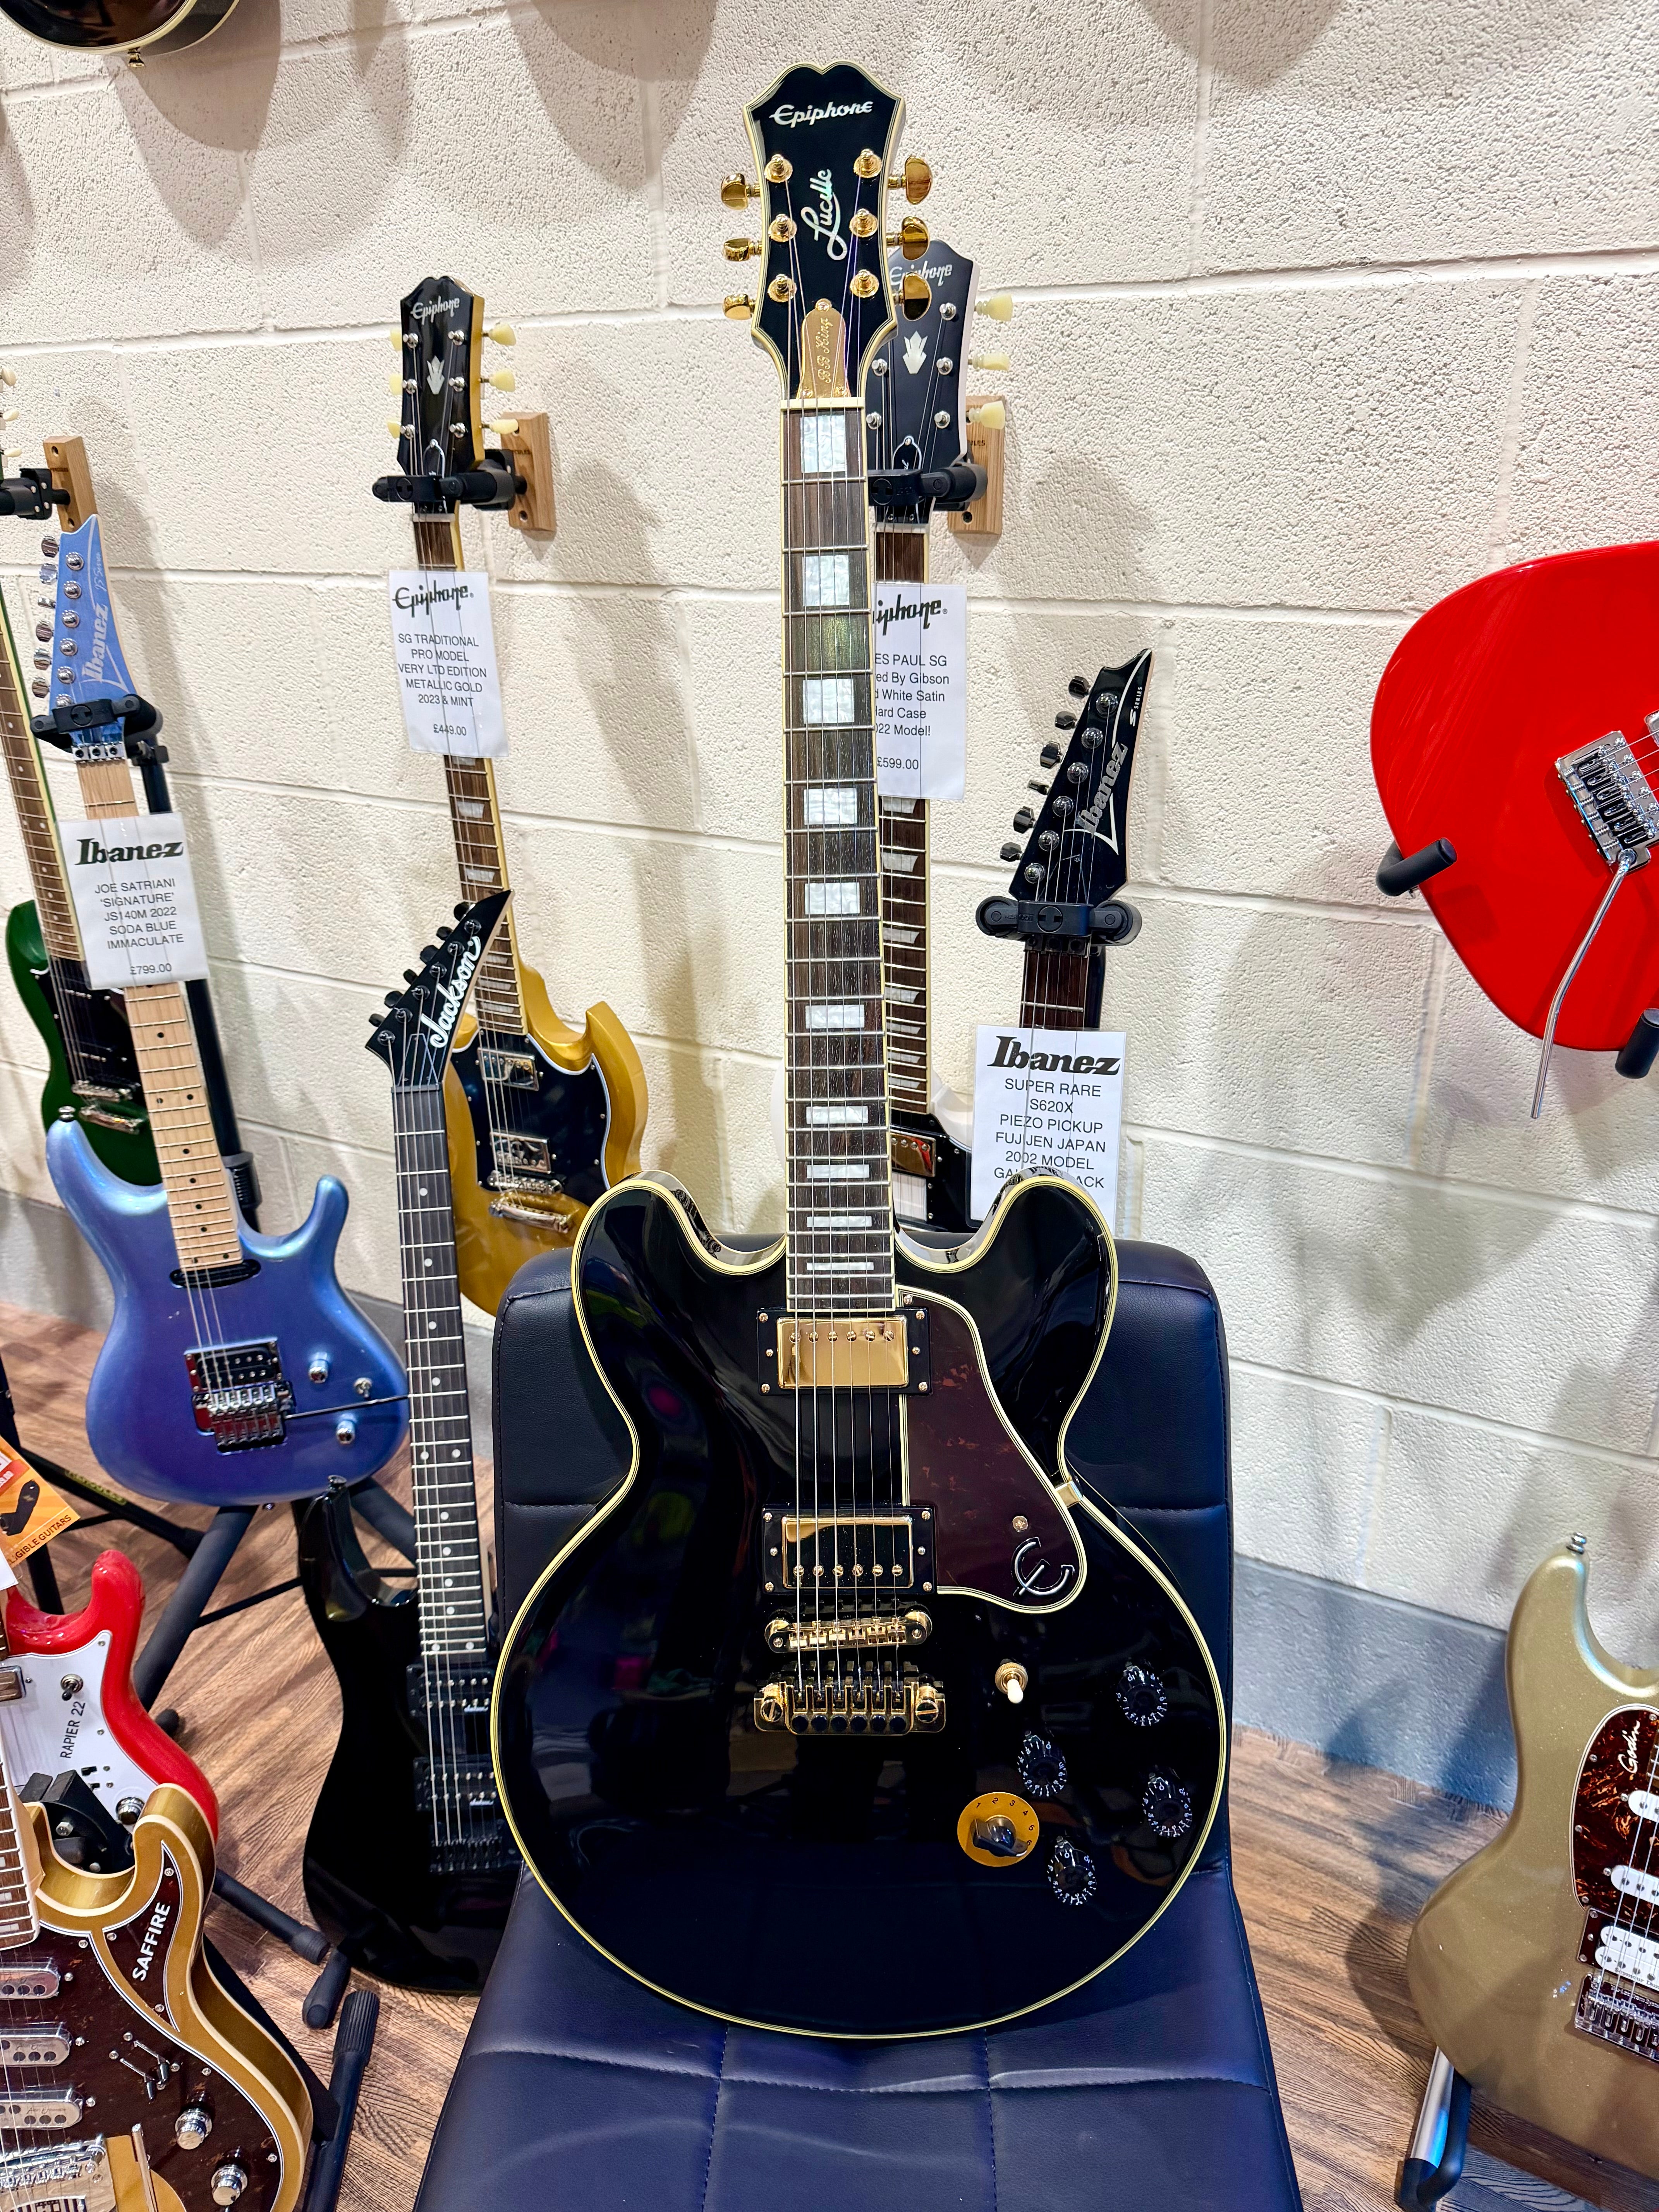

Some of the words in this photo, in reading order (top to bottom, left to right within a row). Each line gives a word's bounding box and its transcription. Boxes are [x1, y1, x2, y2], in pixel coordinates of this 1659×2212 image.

[769, 101, 873, 128] Epiphone
[800, 169, 847, 260] Lucille
[889, 260, 953, 291] Ephone
[410, 295, 460, 325] Epiphone
[816, 318, 833, 354] King
[392, 580, 469, 618] Epiphone
[872, 594, 941, 635] iphone
[81, 603, 108, 683] Ibanez
[398, 633, 412, 644] SG
[414, 634, 479, 647] TRADITIONAL
[411, 649, 433, 659] PRO
[436, 650, 469, 661] MODEL
[875, 653, 890, 665] ES
[893, 654, 926, 666] PAUL
[929, 655, 947, 666] SG
[398, 663, 424, 673] VERY
[427, 665, 445, 675] LTD
[447, 666, 487, 678] EDITION
[876, 672, 888, 682] ed
[892, 672, 906, 686] By
[909, 672, 949, 685] Gibson
[406, 678, 452, 690] METALLIC
[455, 682, 483, 692] GOLD
[418, 694, 440, 704] 2023
[442, 696, 448, 705] &
[451, 696, 474, 707] MINT
[882, 689, 913, 701] White
[916, 690, 945, 702] Satin
[875, 706, 893, 717] ard
[897, 707, 926, 719] Case
[1130, 709, 1136, 727] S
[433, 724, 467, 736] £449.00
[876, 723, 890, 734] 22
[894, 724, 931, 736] Model!
[877, 756, 919, 770] £599.00
[1076, 742, 1128, 840] Ibanez
[74, 838, 184, 866] Ibanez
[95, 883, 117, 894] JOE
[121, 878, 175, 891] SATRIANI
[104, 909, 148, 922] JS140M
[150, 906, 177, 918] 2022
[109, 924, 143, 935] SODA
[146, 920, 177, 931] BLUE
[107, 933, 185, 949] IMMACULATE
[130, 963, 172, 975] £799.00
[420, 936, 481, 1048] Jackson
[987, 1035, 1121, 1075] Ibanez
[1005, 1078, 1054, 1094] SUPER
[1060, 1083, 1101, 1097] RARE
[1030, 1098, 1073, 1113] S620X
[1000, 1114, 1043, 1129] PIEZO
[1048, 1119, 1103, 1134] PICKUP
[1057, 1138, 1106, 1152] JAPAN
[1005, 1151, 1037, 1164] 2002
[1042, 1154, 1094, 1170] MODEL
[994, 1167, 1018, 1178] GA
[1076, 1175, 1104, 1188] ACK
[7, 1538, 40, 1565] LIGIBLE
[38, 1515, 72, 1540] GUITARS
[60, 1720, 81, 1759] RAPIER
[71, 1701, 86, 1716] 22
[1618, 1720, 1640, 1774] Godin
[132, 1902, 170, 1981] SAFFIRE
